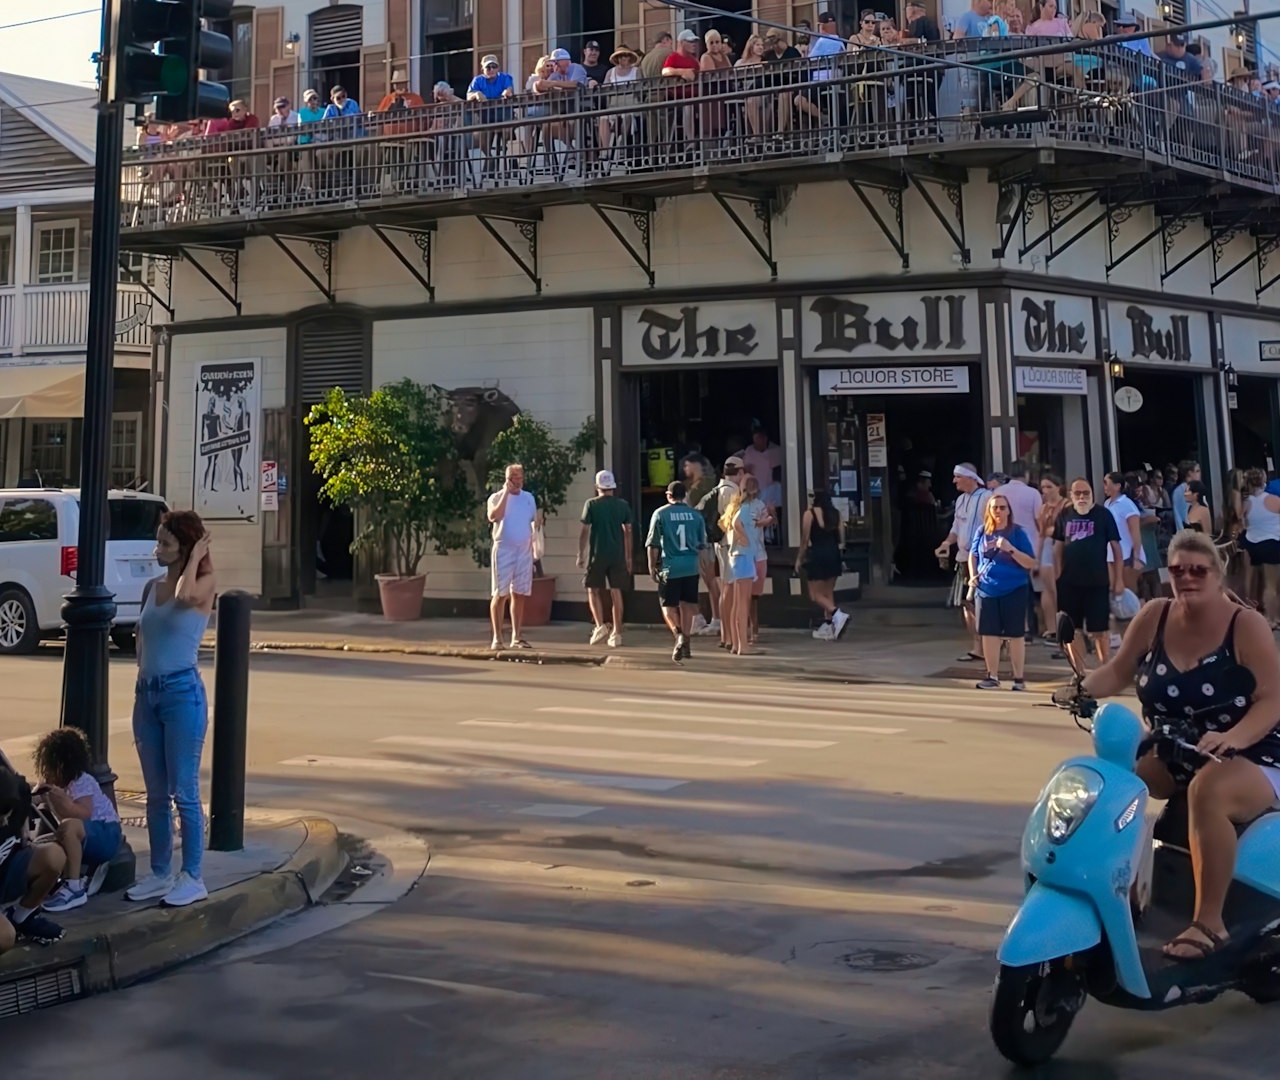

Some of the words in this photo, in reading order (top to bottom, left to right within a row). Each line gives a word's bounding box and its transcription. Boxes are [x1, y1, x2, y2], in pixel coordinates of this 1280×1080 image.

[638, 306, 759, 360] The
[809, 295, 966, 352] Bull
[1021, 297, 1087, 354] The
[1126, 306, 1191, 362] Bull
[840, 369, 897, 384] LIQUOR
[901, 369, 954, 384] STORE
[868, 426, 880, 437] 21
[265, 472, 274, 482] 21
[676, 524, 689, 551] 1
